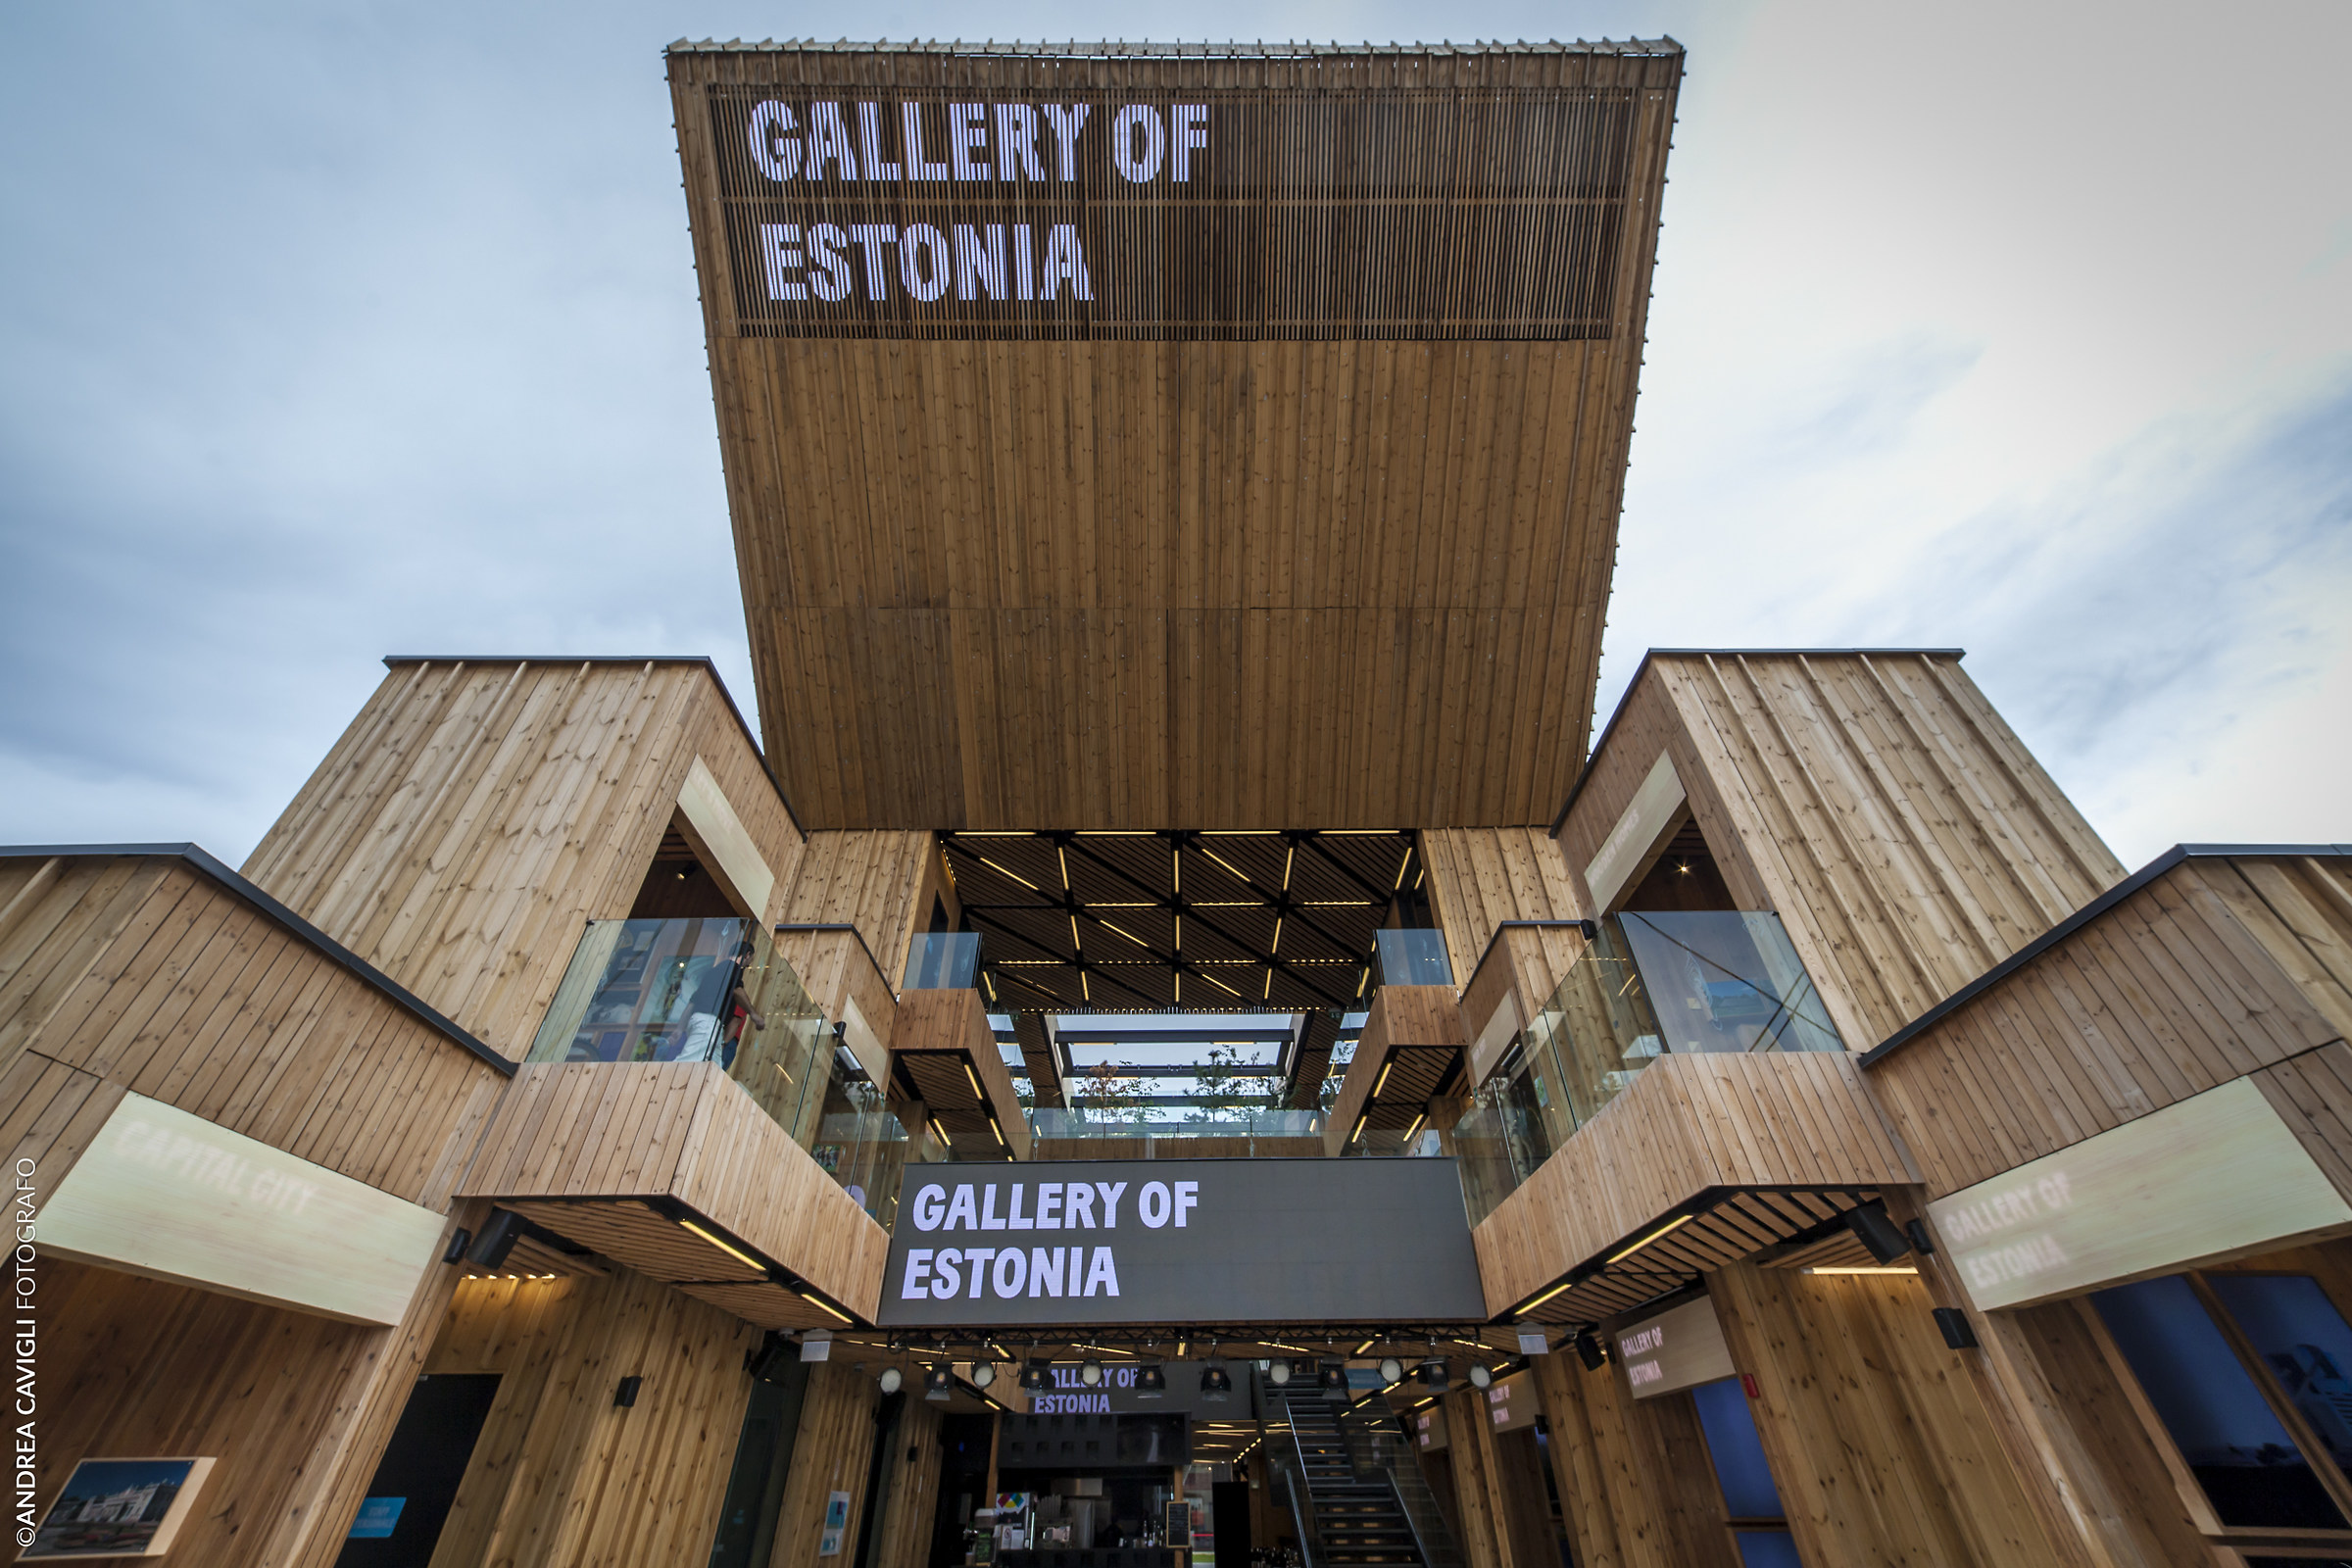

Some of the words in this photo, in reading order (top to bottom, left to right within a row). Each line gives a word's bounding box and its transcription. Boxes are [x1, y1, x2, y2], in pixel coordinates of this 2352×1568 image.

[749, 100, 1091, 182] GALLERY
[1113, 103, 1208, 183] OF
[760, 222, 1094, 302] ESTONIA
[114, 1120, 251, 1197] CAPITAL
[250, 1168, 319, 1214] CITY
[912, 1182, 1128, 1232] GALLERY
[1138, 1180, 1199, 1228] OF
[1944, 1185, 2038, 1243] GALLERY
[2037, 1170, 2073, 1210] OF
[902, 1247, 1120, 1299] ESTONIA
[1966, 1234, 2069, 1289] ESTONIA
[1621, 1330, 1653, 1357] GALLERY
[1034, 1394, 1111, 1413] ESTONIA
